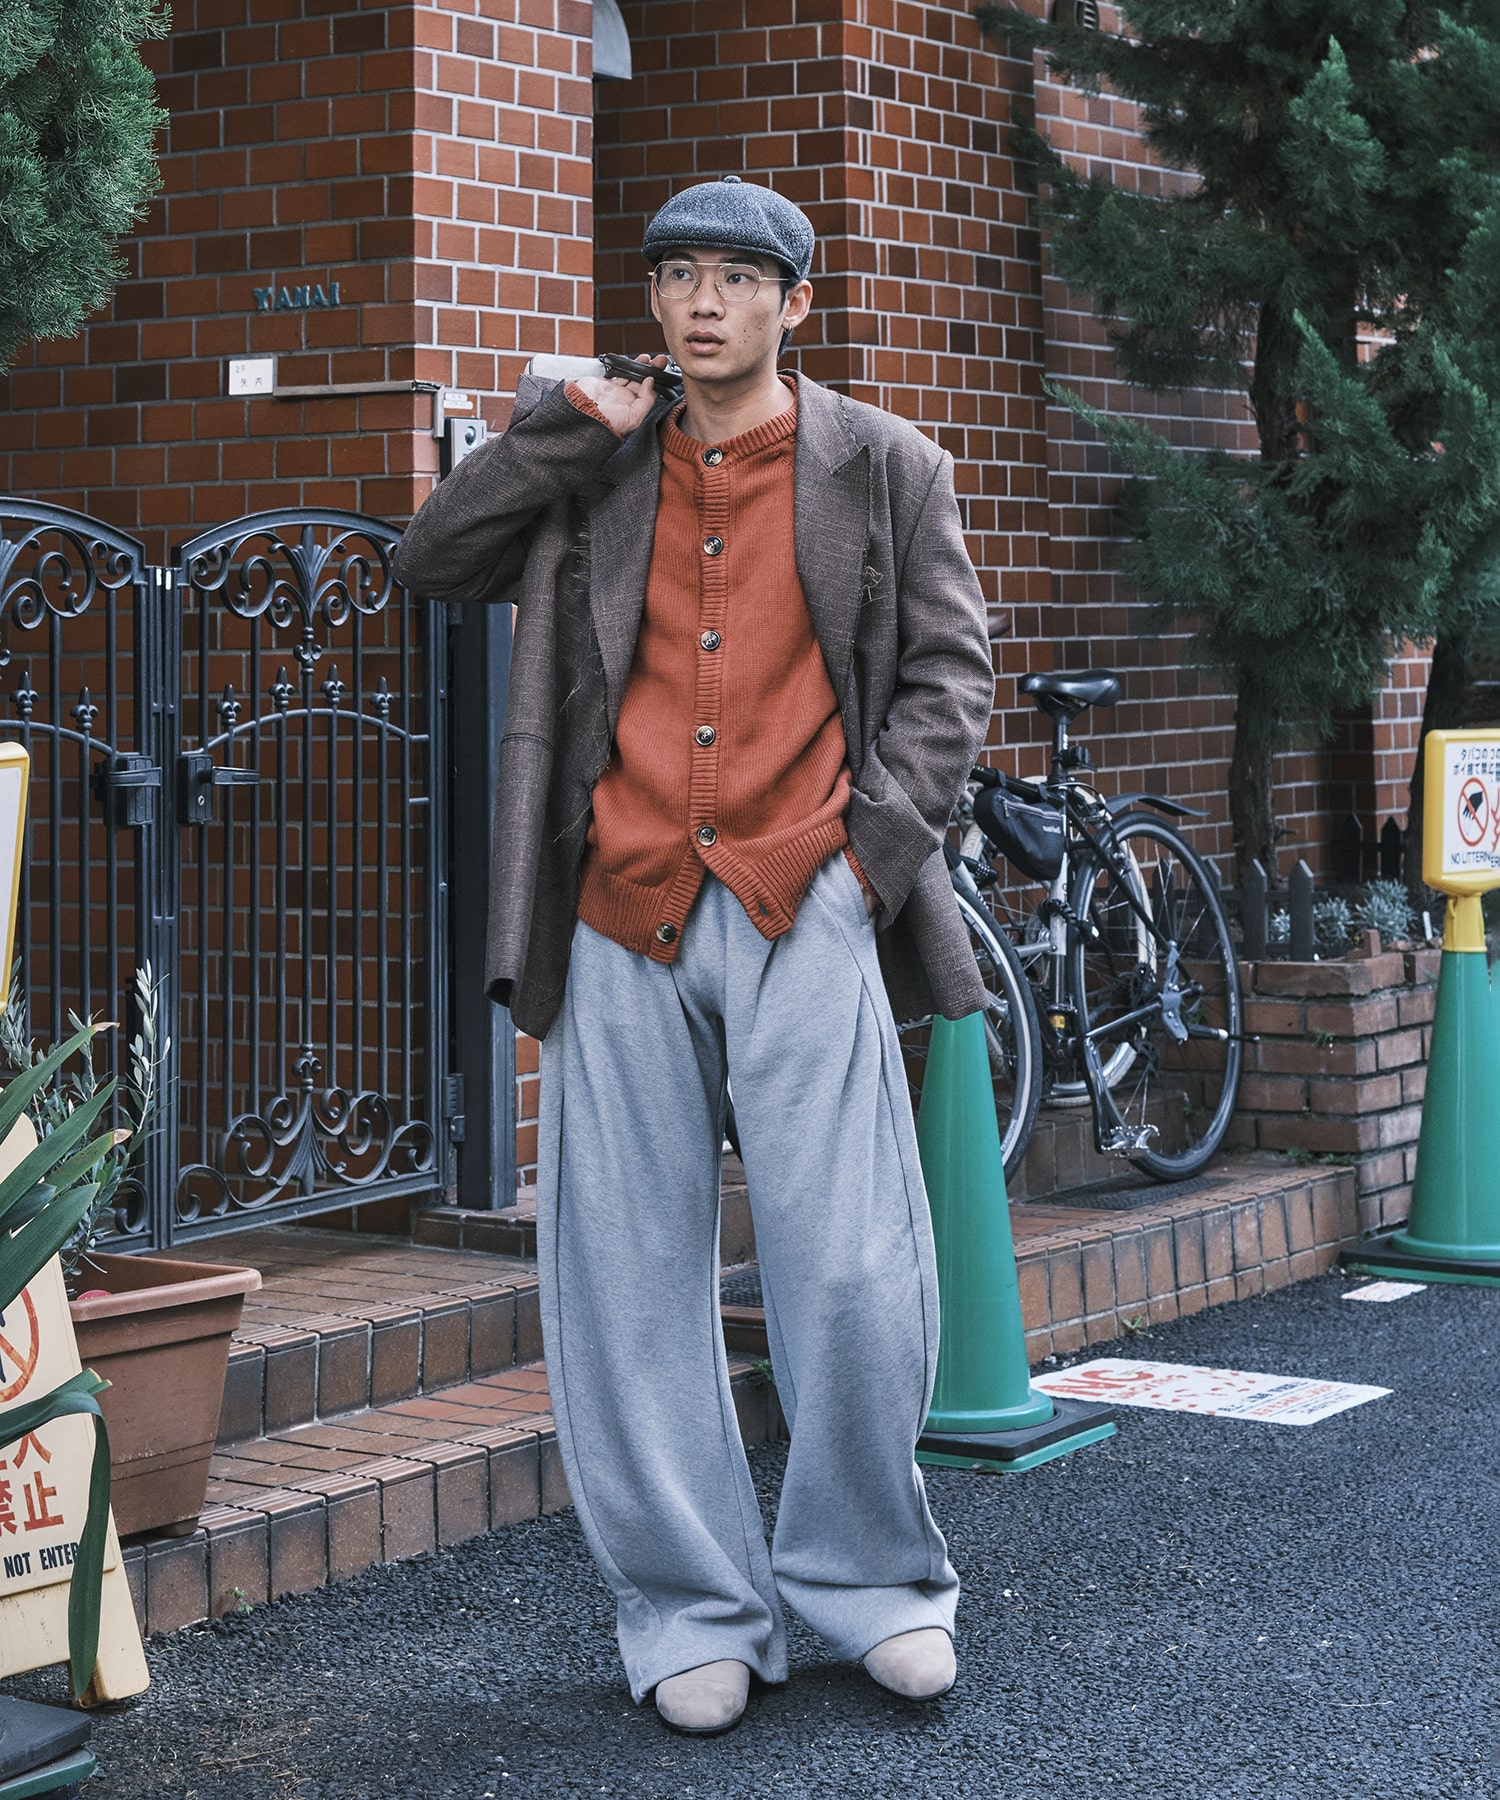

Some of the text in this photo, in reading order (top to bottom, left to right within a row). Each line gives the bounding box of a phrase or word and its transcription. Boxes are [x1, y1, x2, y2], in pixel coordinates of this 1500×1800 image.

[253, 282, 340, 310] YANAI
[1451, 852, 1460, 864] NO
[4, 1552, 31, 1578] NOT
